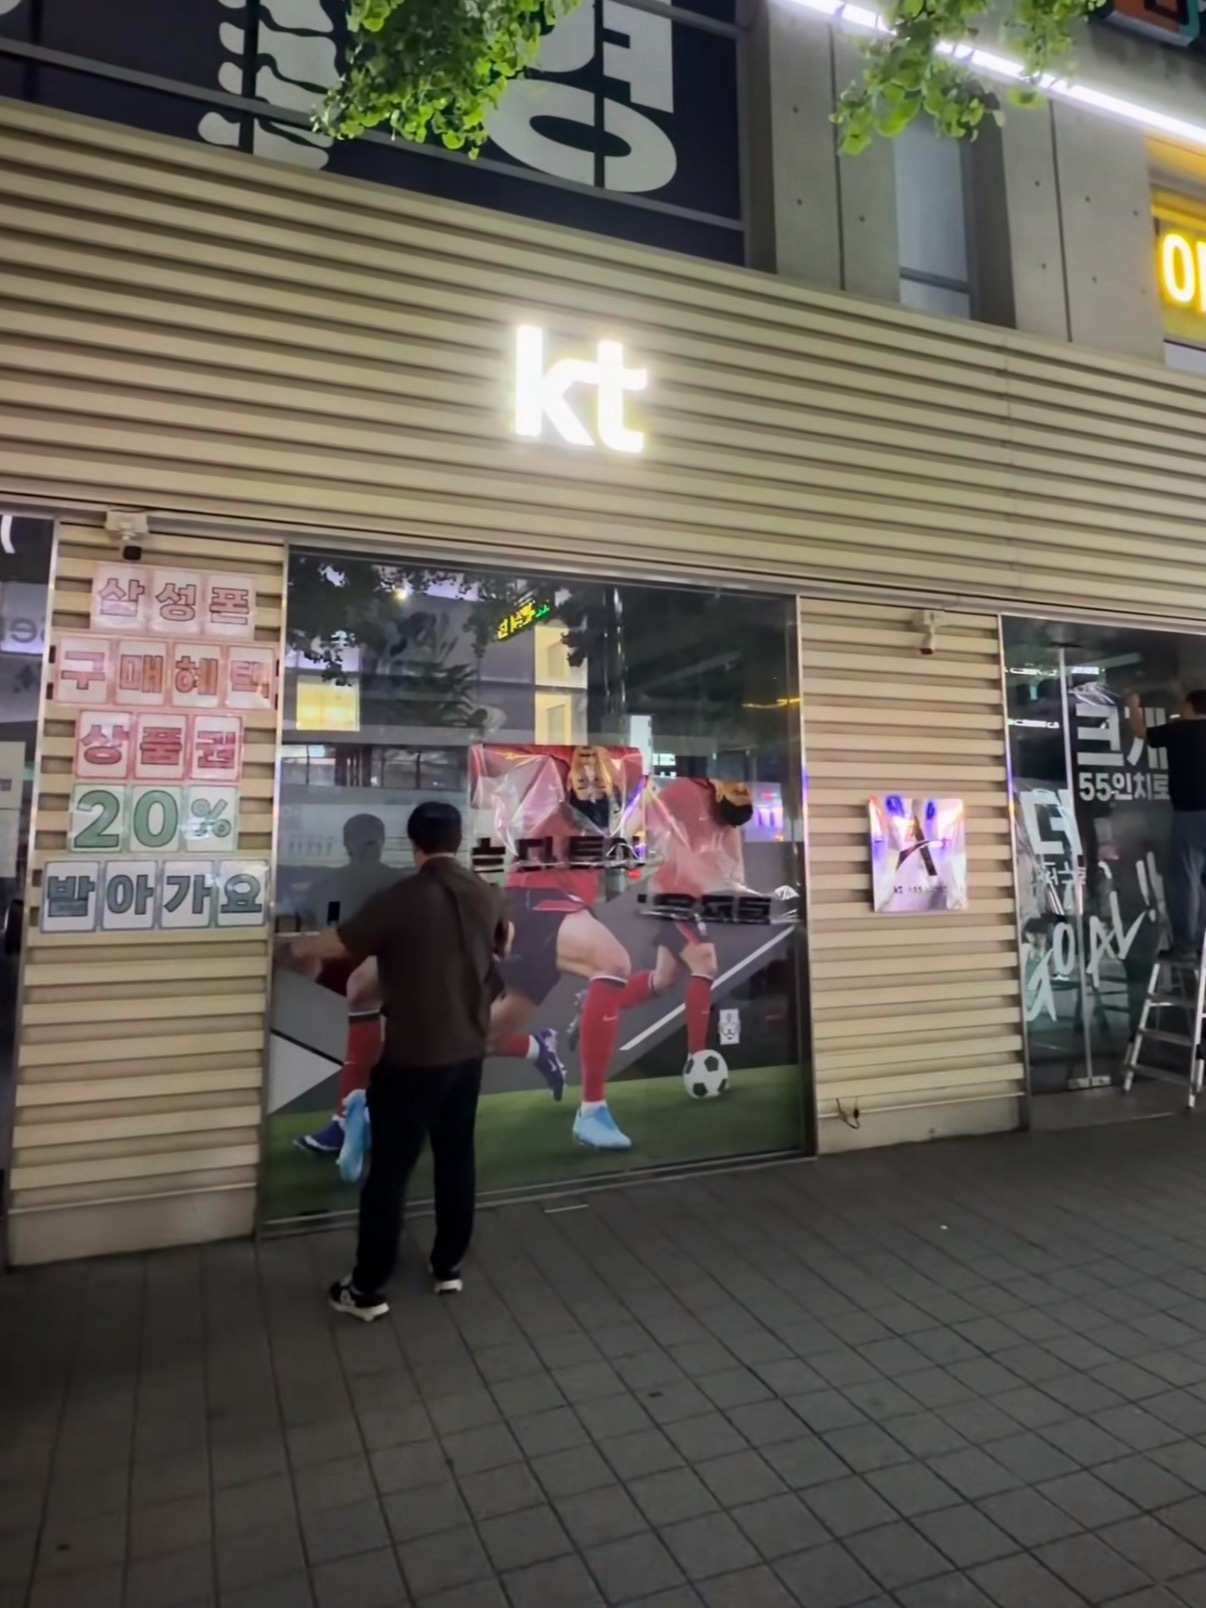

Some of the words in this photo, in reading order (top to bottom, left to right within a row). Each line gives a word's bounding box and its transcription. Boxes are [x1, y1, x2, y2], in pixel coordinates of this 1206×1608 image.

[515, 323, 648, 453] kt
[97, 577, 251, 625] 삼성폰
[61, 651, 271, 699] 구매혜택
[80, 724, 236, 769] 상품권
[73, 789, 232, 849] 20%
[47, 874, 263, 918] 받아가요
